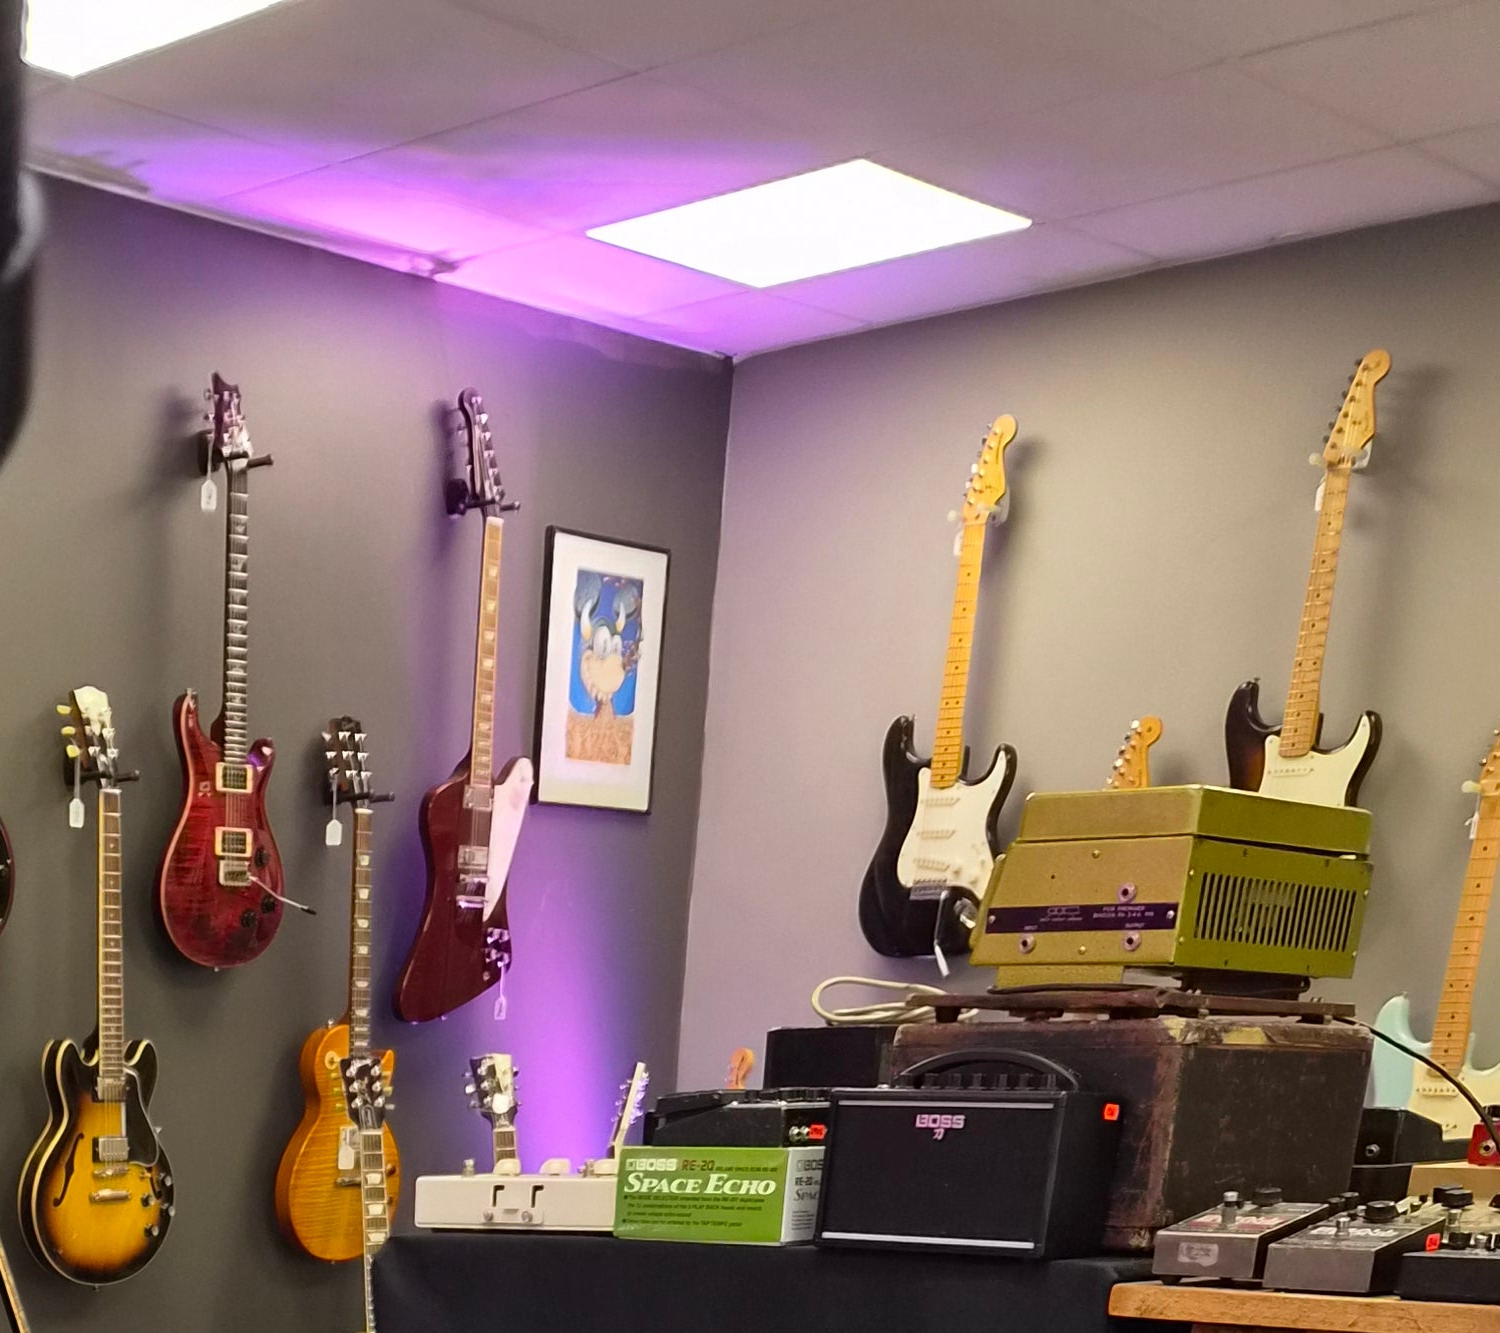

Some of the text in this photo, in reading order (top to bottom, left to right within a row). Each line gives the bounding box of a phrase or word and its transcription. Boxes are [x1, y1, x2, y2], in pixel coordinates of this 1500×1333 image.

[915, 1114, 966, 1129] BOSS
[636, 1158, 678, 1171] BOSS
[681, 1160, 715, 1172] RE-20
[624, 1172, 777, 1195] SPACE ECHO
